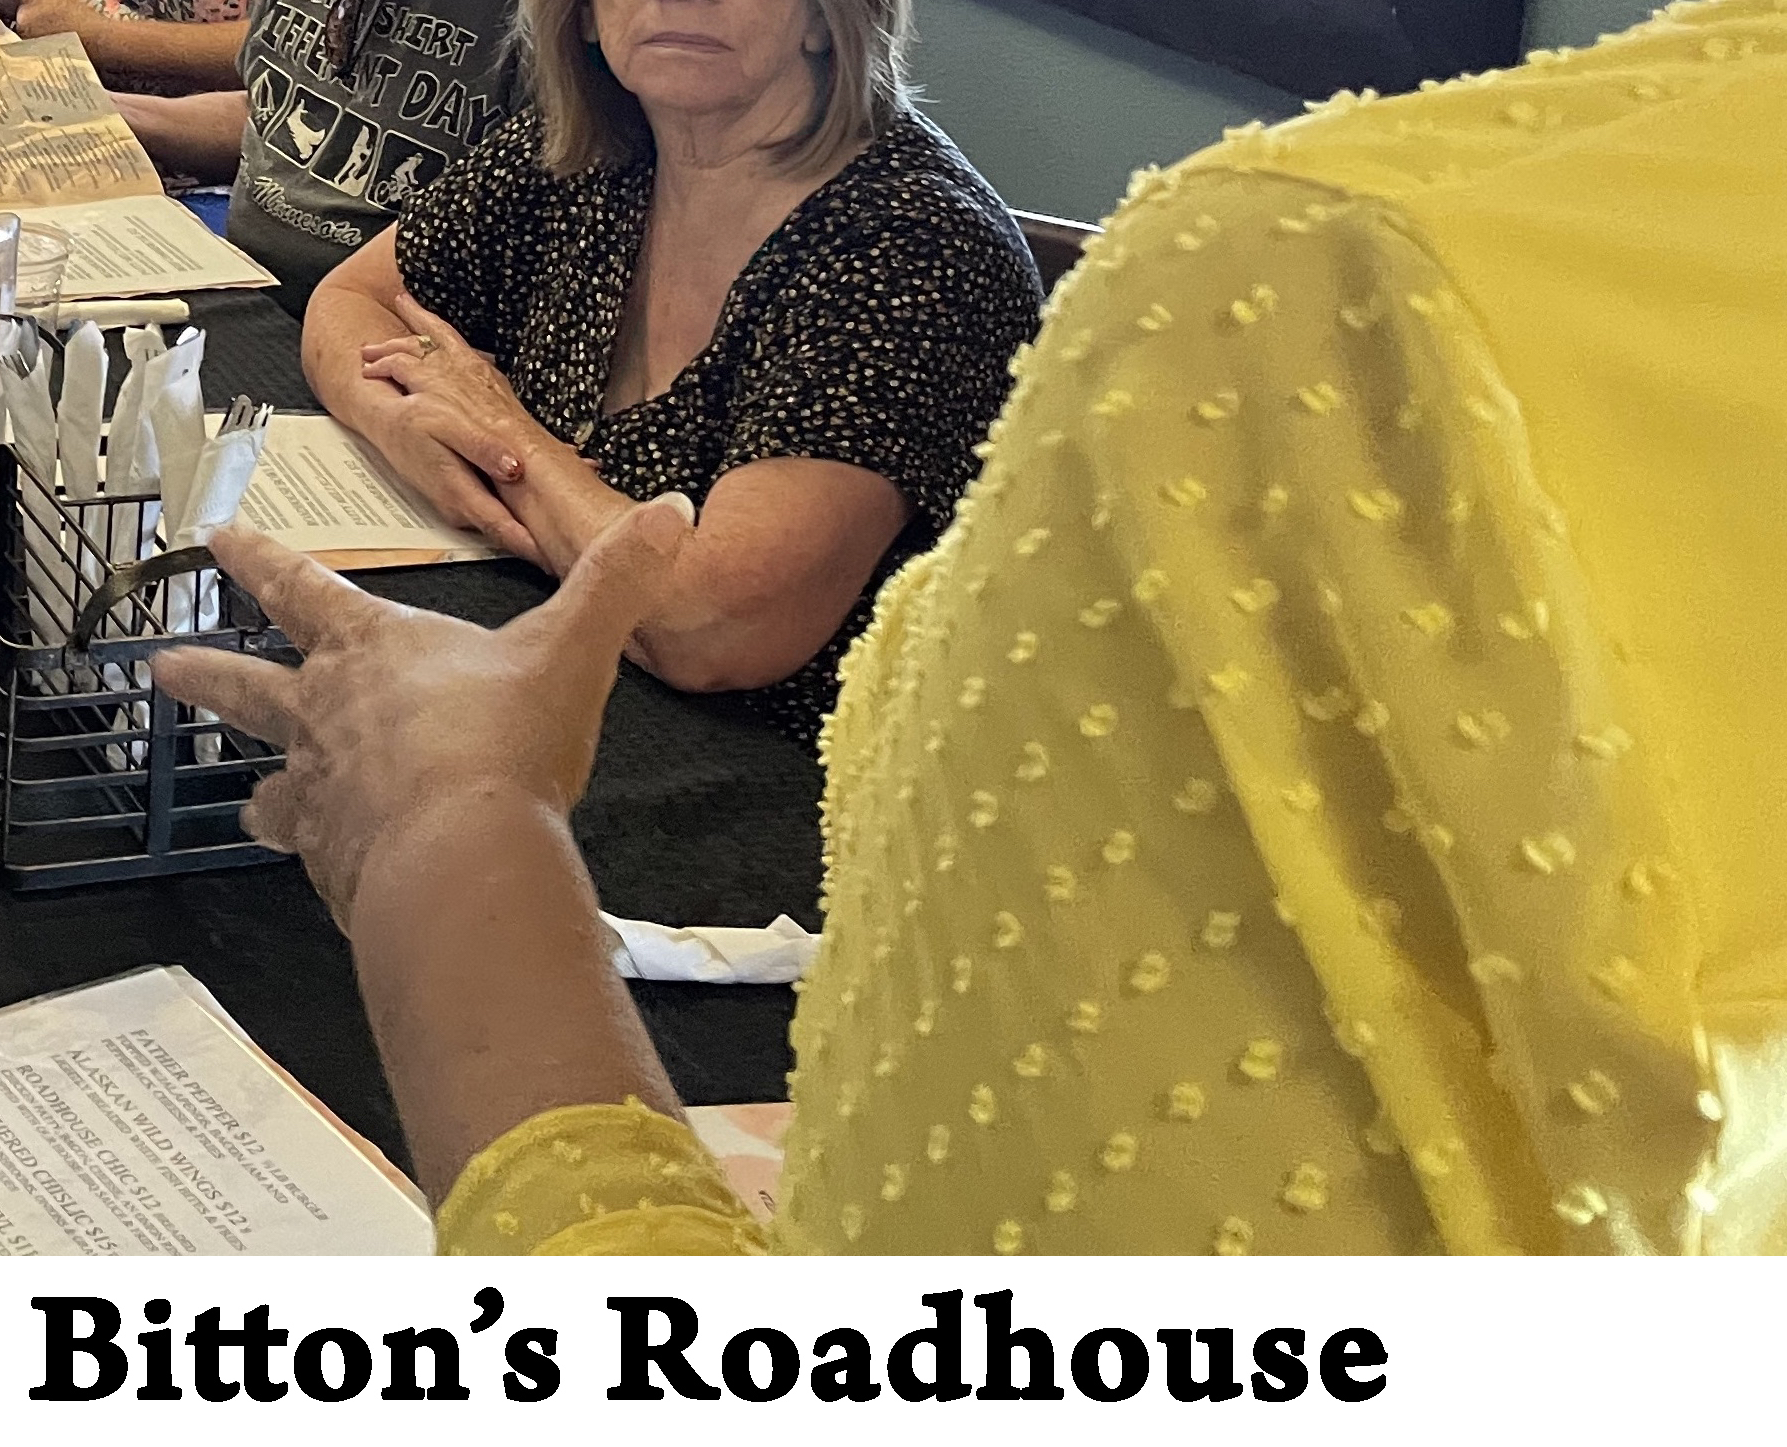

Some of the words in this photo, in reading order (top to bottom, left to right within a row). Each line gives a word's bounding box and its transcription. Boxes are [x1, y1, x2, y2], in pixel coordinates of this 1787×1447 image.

[261, 2, 403, 108] IFFENT
[398, 60, 504, 148] DAY
[374, 2, 478, 66] SHIRT
[252, 174, 364, 248] Minnesota
[130, 1029, 189, 1081] FATHER
[183, 1082, 239, 1131] PEPPER
[233, 1132, 265, 1155] $12
[15, 1065, 103, 1148] ROADHOUSE
[95, 1150, 138, 1185] CHIC
[129, 1186, 161, 1210] $12
[66, 1050, 138, 1112] ALASKAN
[133, 1113, 173, 1150] WILD
[170, 1152, 223, 1200] WINGS
[215, 1202, 247, 1226] $12
[193, 1133, 226, 1159] FRIES
[32, 1170, 94, 1225] CHISLIC
[85, 1227, 118, 1250] $15
[156, 1166, 184, 1187] FISH
[213, 1225, 248, 1252] FRIES
[261, 1183, 289, 1203] AND
